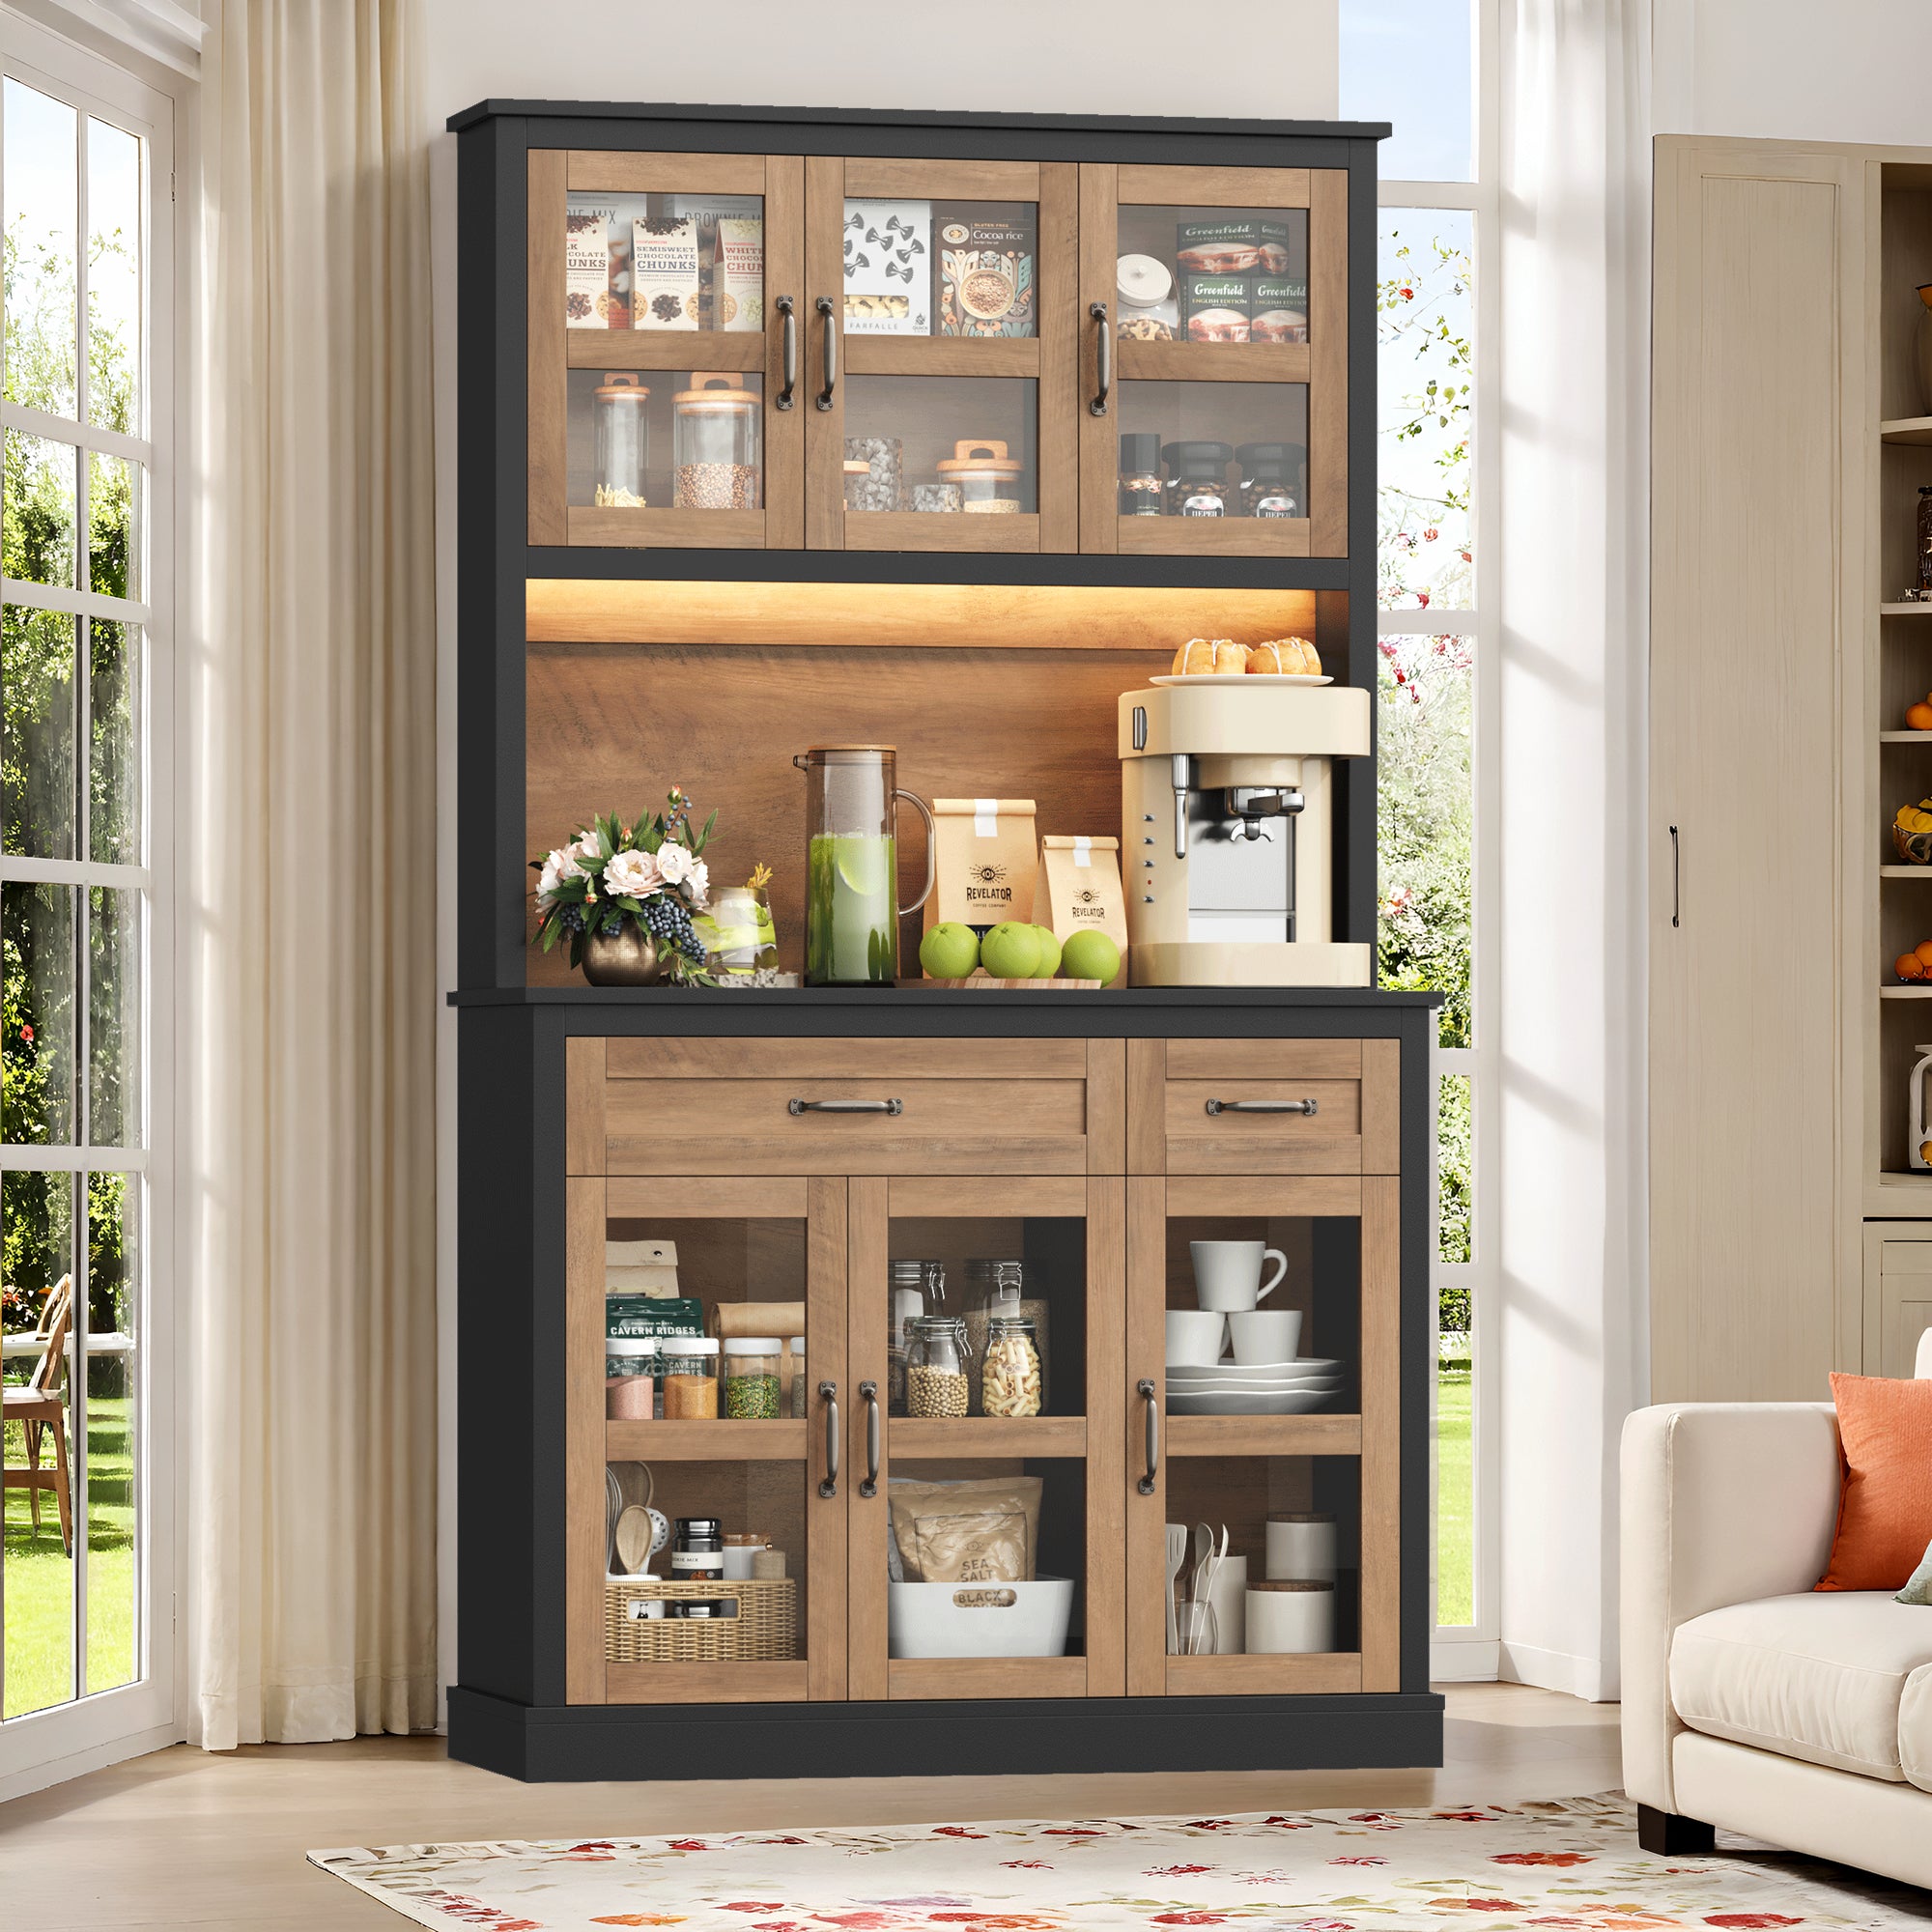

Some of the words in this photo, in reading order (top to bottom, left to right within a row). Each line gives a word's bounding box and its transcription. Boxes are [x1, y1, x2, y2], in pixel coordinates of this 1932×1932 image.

[973, 230, 1003, 240] Cocoa
[1006, 231, 1023, 240] rice
[1185, 225, 1250, 236] Greenfield
[637, 261, 696, 270] CHUNKS
[1194, 284, 1243, 295] Greenfield
[1257, 284, 1306, 297] Greenfield
[966, 887, 1012, 902] REVELATOR
[1072, 907, 1105, 919] REVELATOR
[610, 1327, 653, 1335] CAVERN
[657, 1327, 696, 1335] RIDGES
[962, 1558, 989, 1571] SEA
[960, 1570, 992, 1582] SALT
